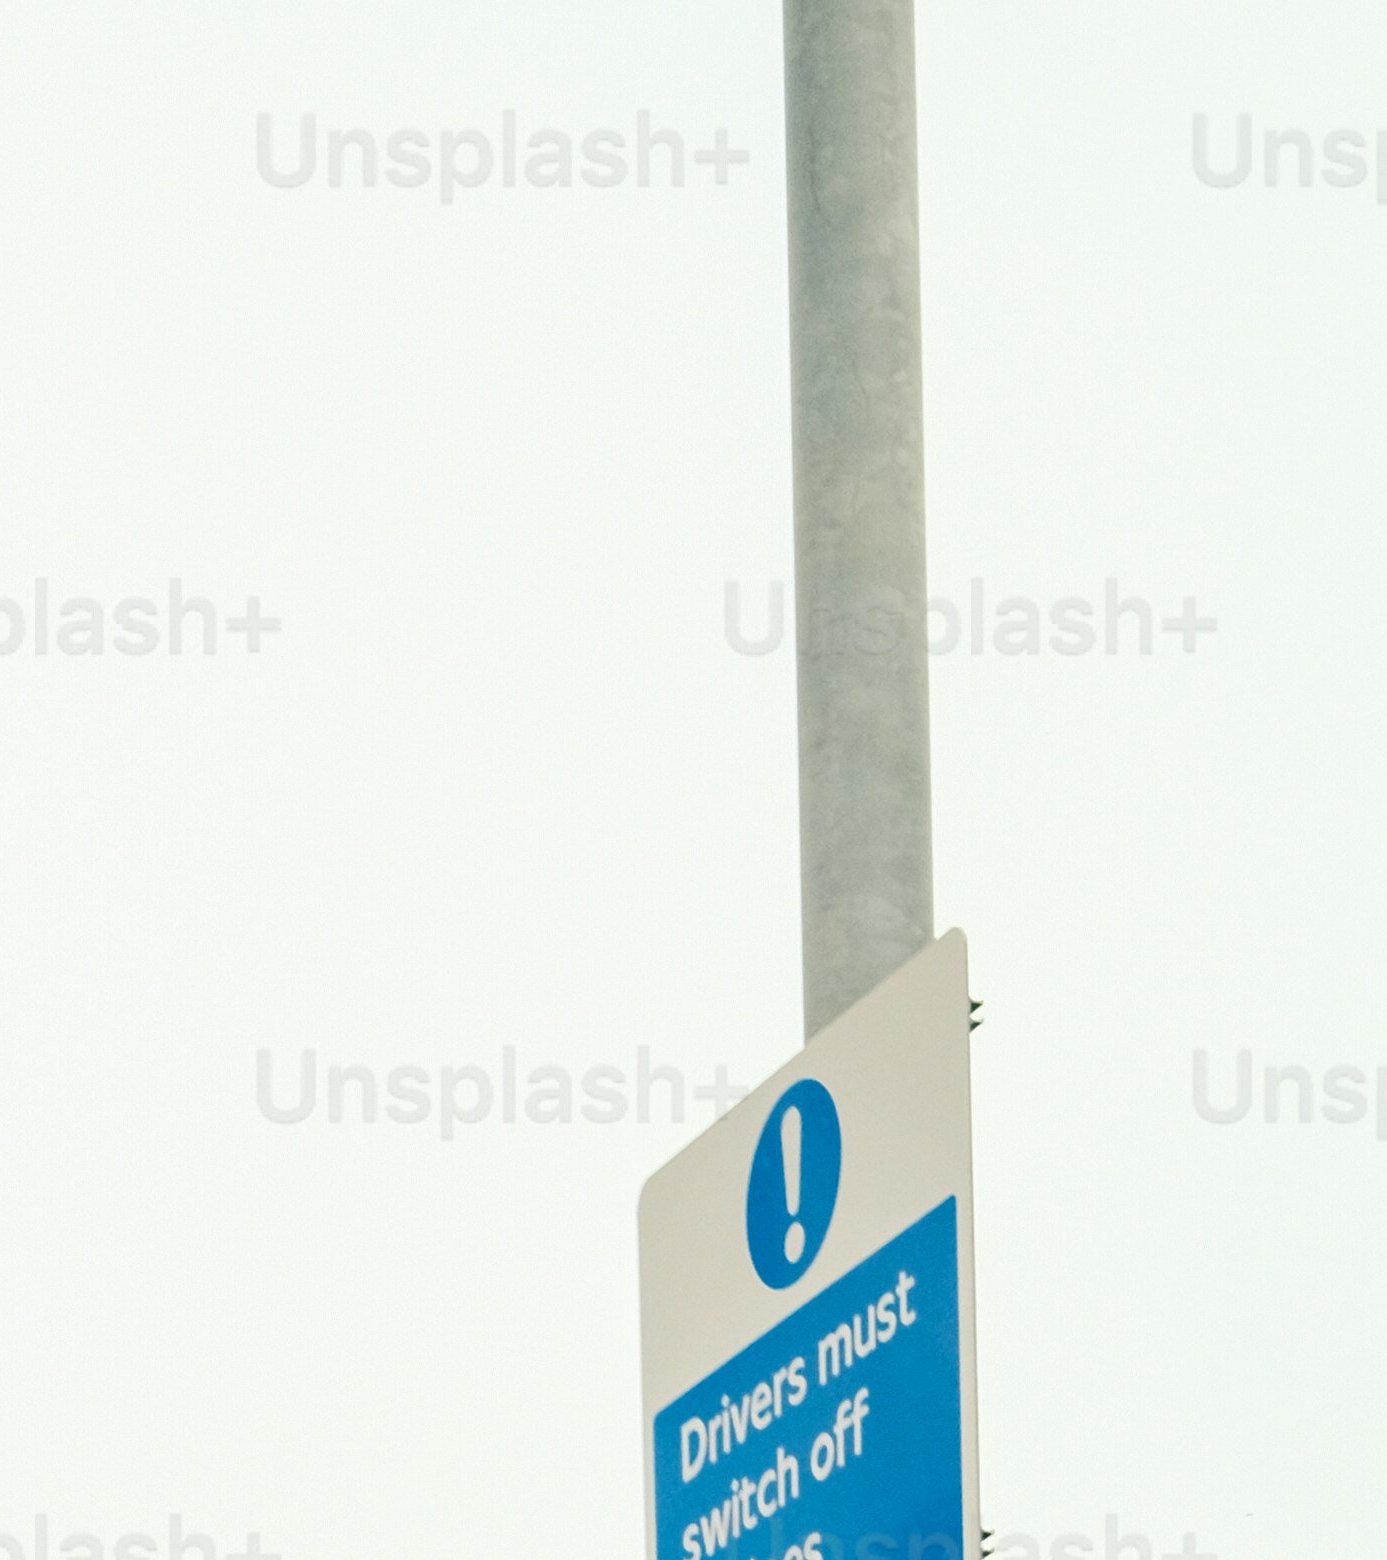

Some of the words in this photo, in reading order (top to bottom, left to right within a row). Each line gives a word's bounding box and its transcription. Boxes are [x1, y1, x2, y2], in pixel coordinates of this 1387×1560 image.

[680, 1356, 808, 1484] Drivers
[818, 1270, 917, 1386] must
[810, 1387, 870, 1482] off
